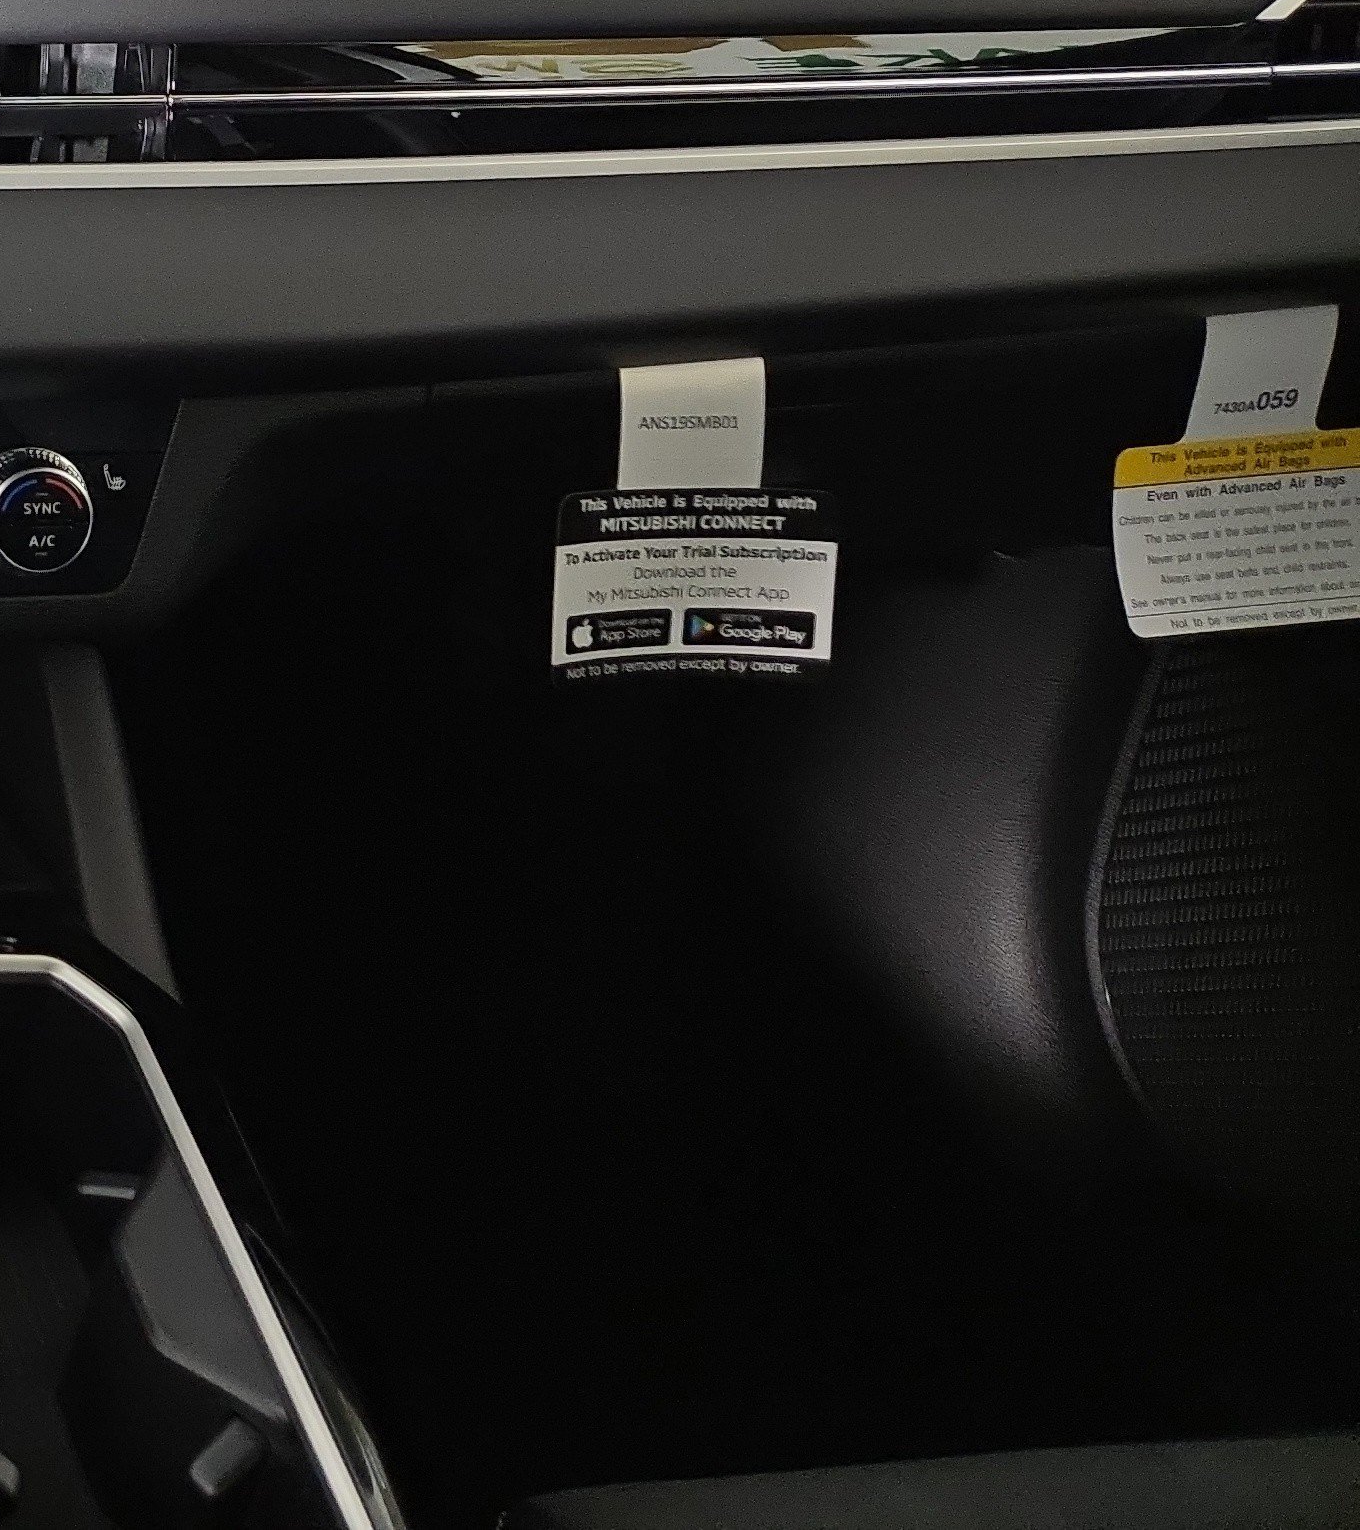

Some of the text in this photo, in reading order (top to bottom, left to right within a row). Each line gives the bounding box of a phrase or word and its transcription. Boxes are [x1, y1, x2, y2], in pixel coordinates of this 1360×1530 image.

[1150, 436, 1347, 463] This Vehicle is Equipped with
[1184, 456, 1310, 475] Advanced Air Bags
[1147, 475, 1346, 501] Even with Advanced Air Bags
[23, 502, 61, 515] SYNC
[580, 495, 817, 512] This Vehicle is Equipped with
[600, 516, 786, 532] MITSUBISHI CONNECT
[29, 535, 56, 547] A/C
[565, 546, 827, 565] To Activate Your Trial Subscription
[633, 566, 737, 580] Download the
[588, 585, 790, 604] My Mitsubishi Connect App
[600, 626, 661, 642] App Store
[719, 625, 807, 644] Google Play
[566, 667, 586, 679] Not
[588, 665, 601, 676] to
[602, 663, 618, 676] be
[621, 660, 676, 672] removed
[680, 658, 726, 672] except
[729, 659, 748, 672] by
